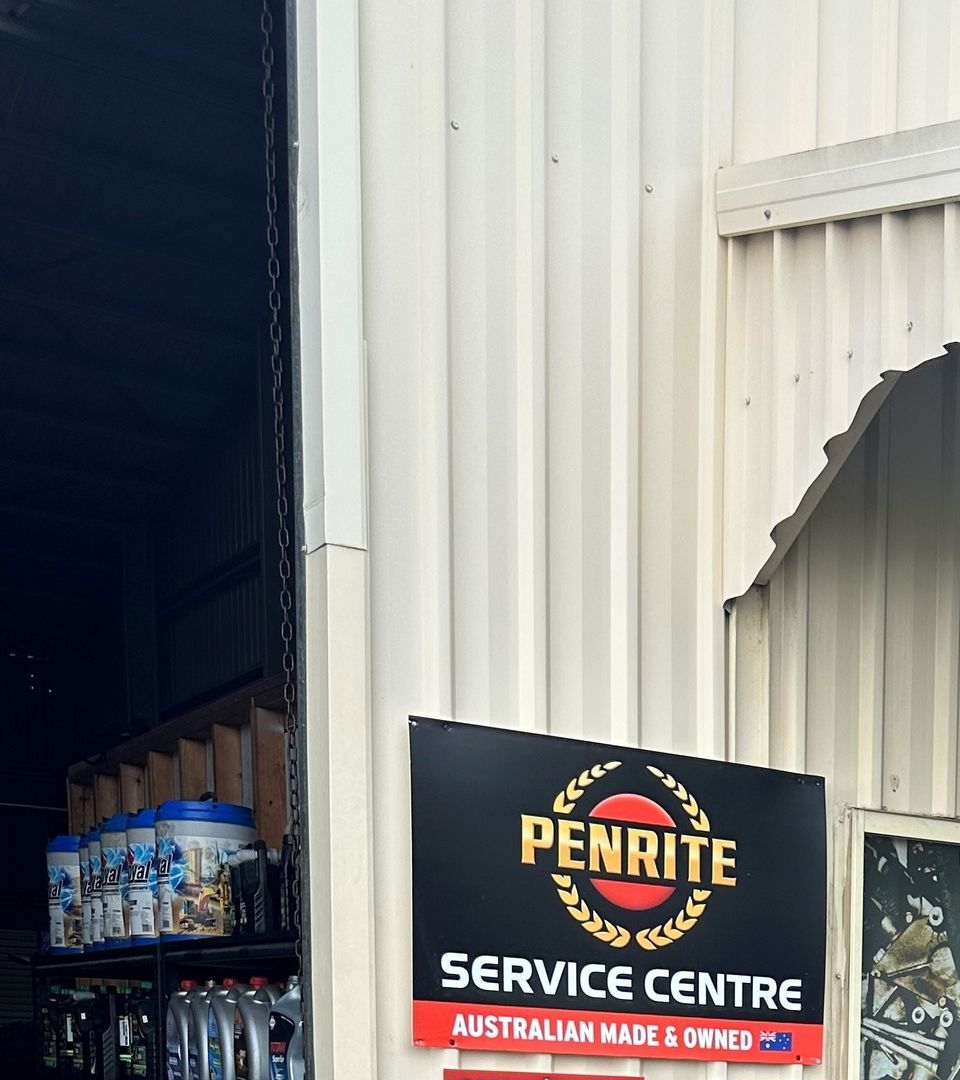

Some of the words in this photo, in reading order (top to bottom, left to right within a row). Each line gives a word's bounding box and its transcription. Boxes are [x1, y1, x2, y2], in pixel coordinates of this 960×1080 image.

[521, 814, 737, 886] PENRITE
[441, 952, 633, 1000] SERVICE
[645, 969, 802, 1011] CENTRE
[452, 1013, 594, 1044] AUSTRALIAN
[600, 1022, 659, 1047] MADE
[664, 1026, 679, 1047] &
[684, 1027, 752, 1051] OWNED
